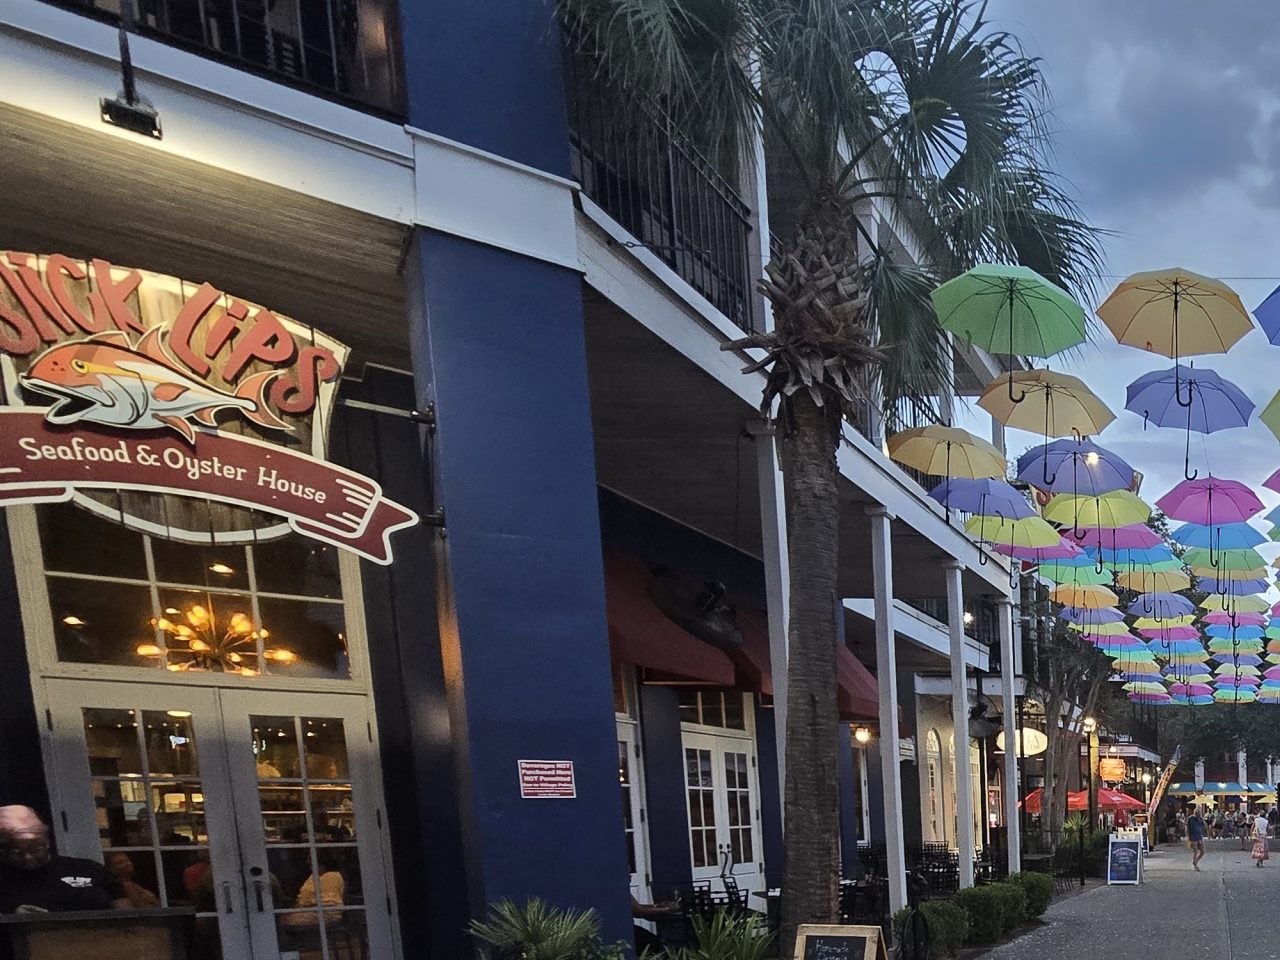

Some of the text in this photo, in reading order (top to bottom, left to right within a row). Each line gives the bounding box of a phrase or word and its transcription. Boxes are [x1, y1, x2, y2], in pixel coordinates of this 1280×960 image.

[18, 437, 327, 503] Seafood & Oyster House
